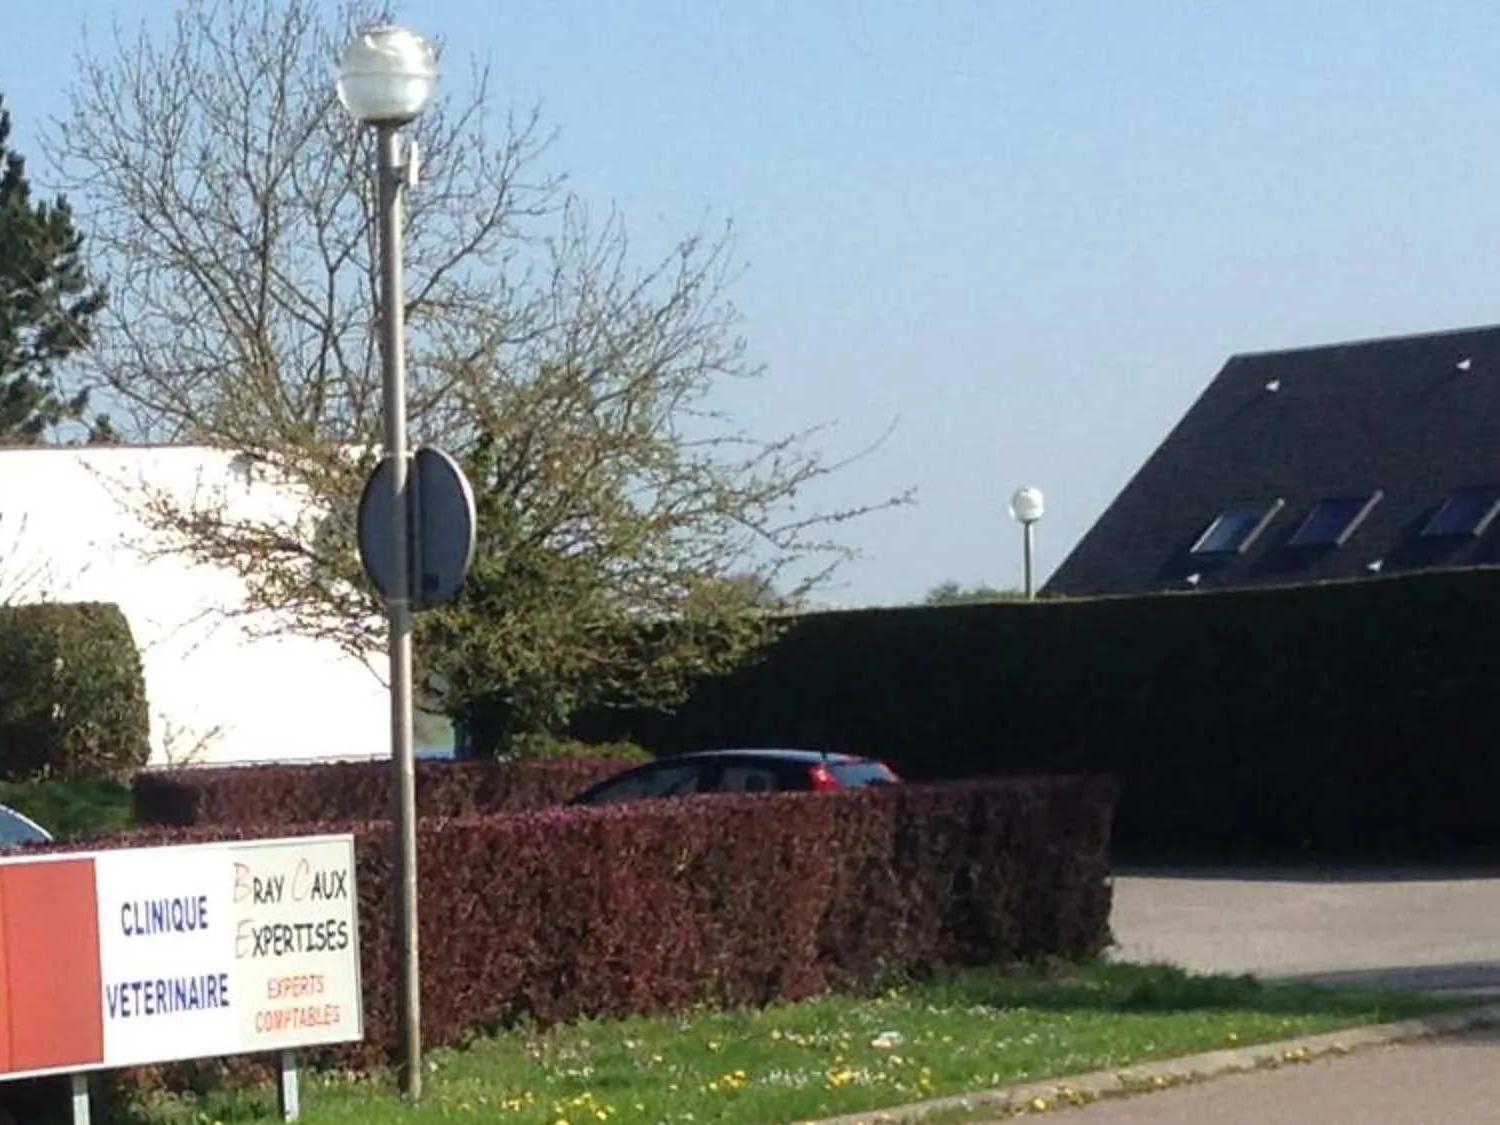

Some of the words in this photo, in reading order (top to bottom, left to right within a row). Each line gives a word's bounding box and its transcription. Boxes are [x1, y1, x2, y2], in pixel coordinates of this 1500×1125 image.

[232, 862, 284, 904] BRAY
[291, 858, 347, 902] CAUX
[121, 896, 208, 936] CLINIQUE
[236, 919, 348, 958] EXPERTISES
[107, 973, 229, 1019] VETERINAIRE
[267, 973, 324, 1000] EXPERTS
[255, 1004, 340, 1033] COMPTABLES
